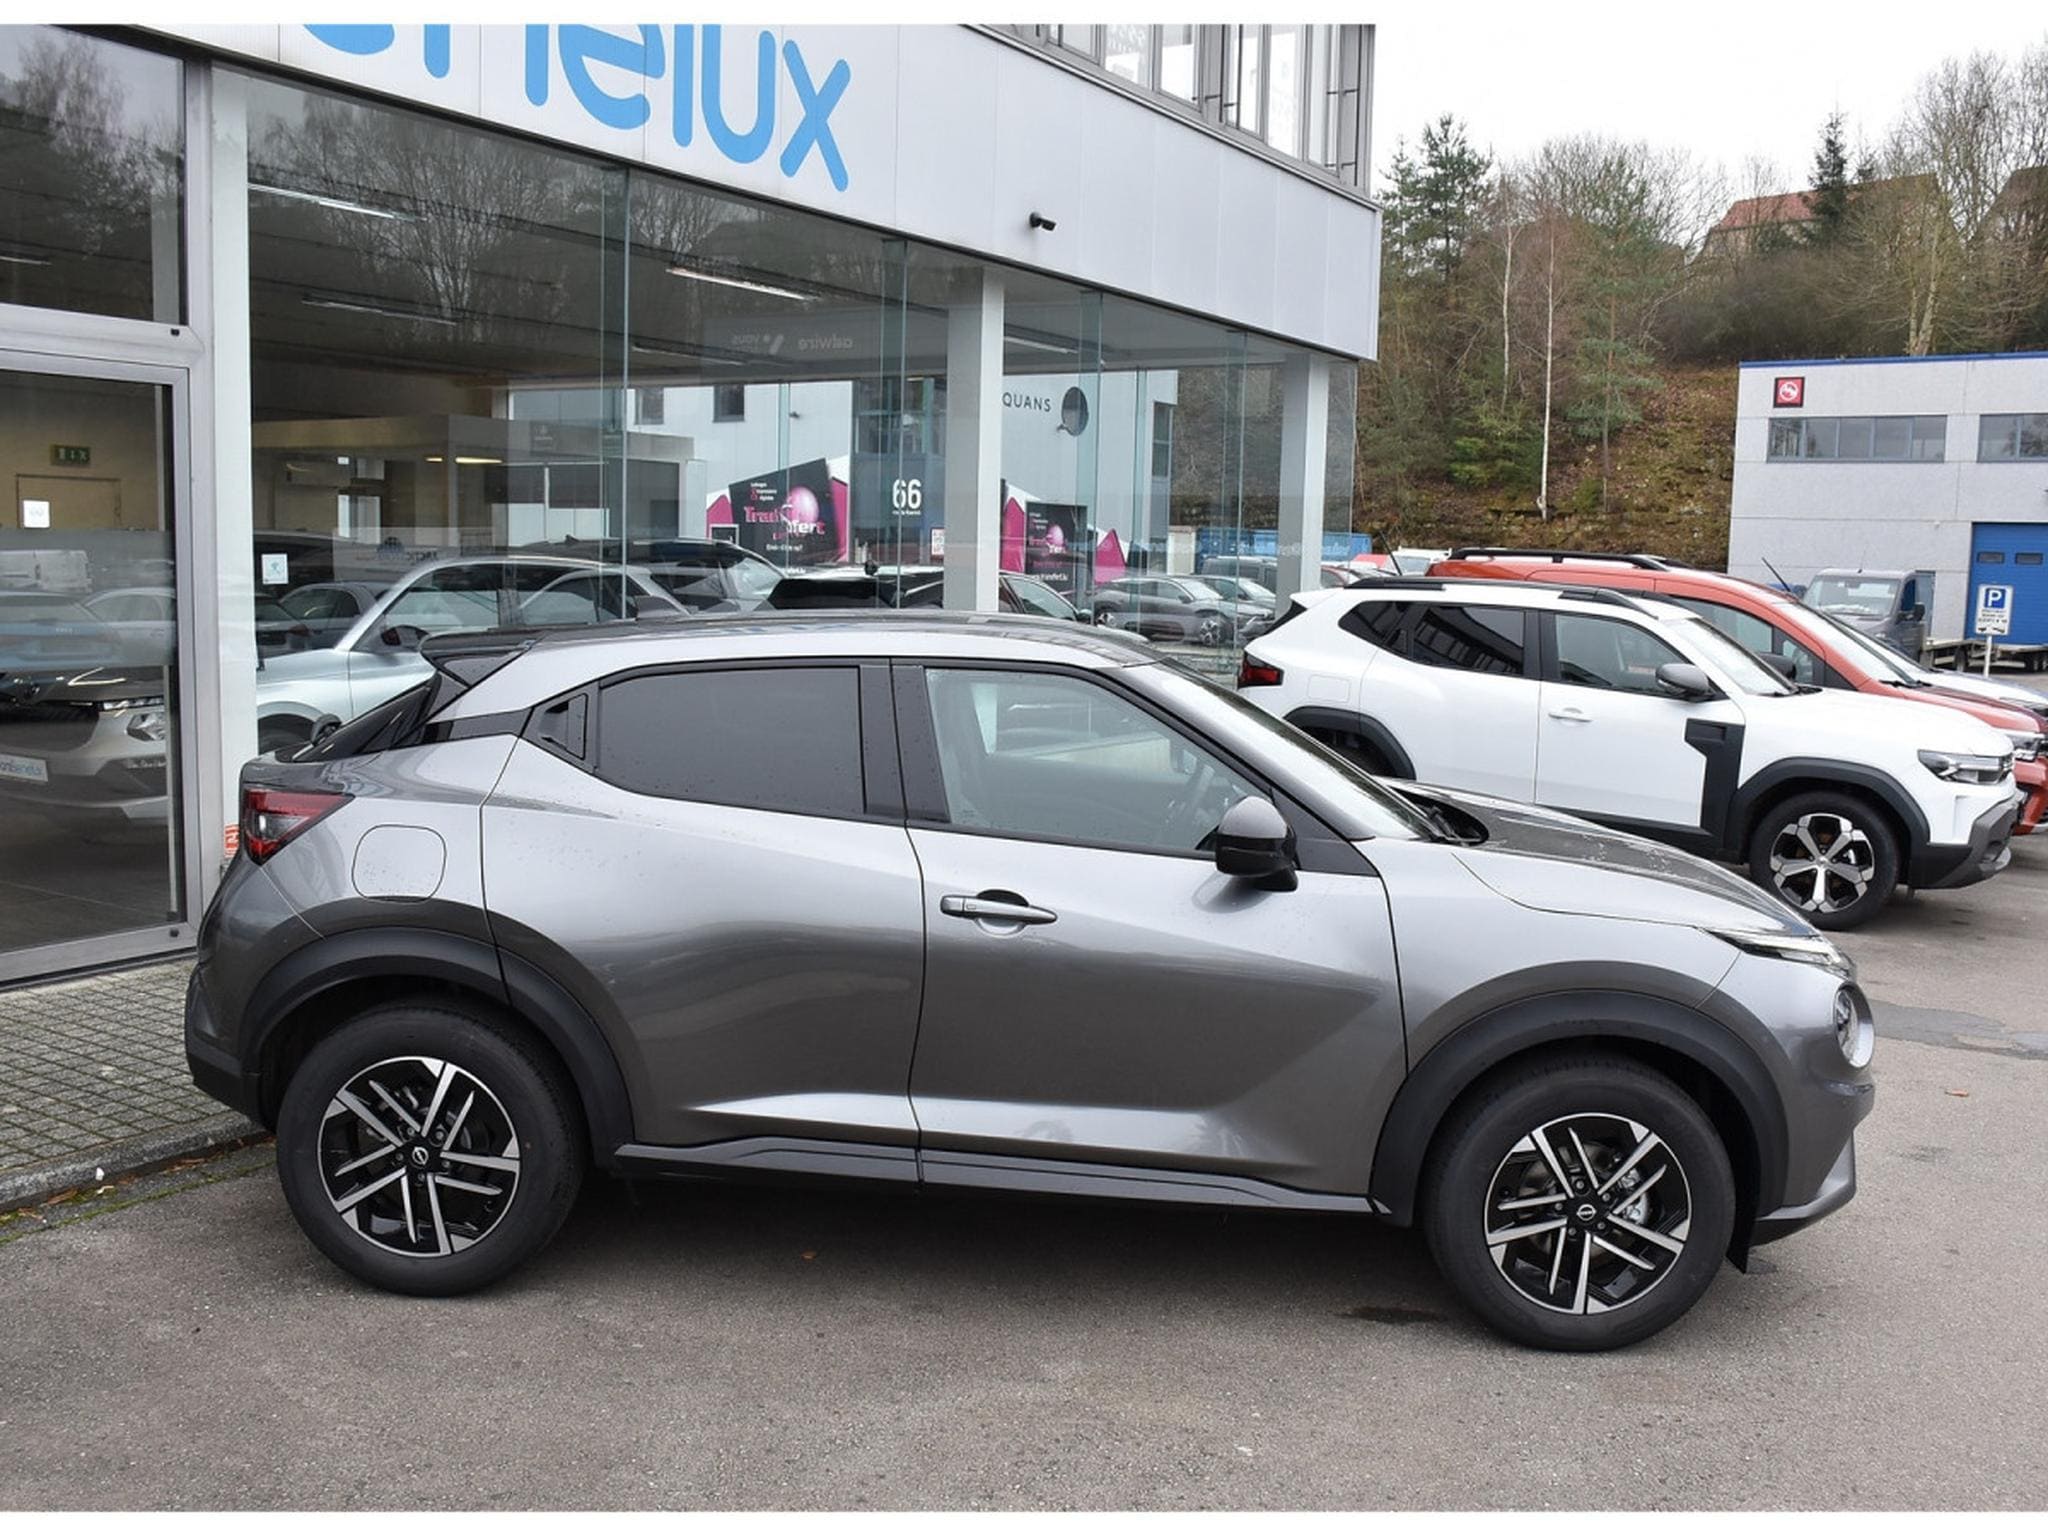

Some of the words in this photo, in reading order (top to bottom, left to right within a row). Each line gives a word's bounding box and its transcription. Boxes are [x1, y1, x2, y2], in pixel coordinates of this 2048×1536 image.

[303, 24, 851, 192] nelux
[1002, 391, 1053, 413] QUANS
[892, 478, 922, 510] 66
[1987, 590, 2002, 607] P
